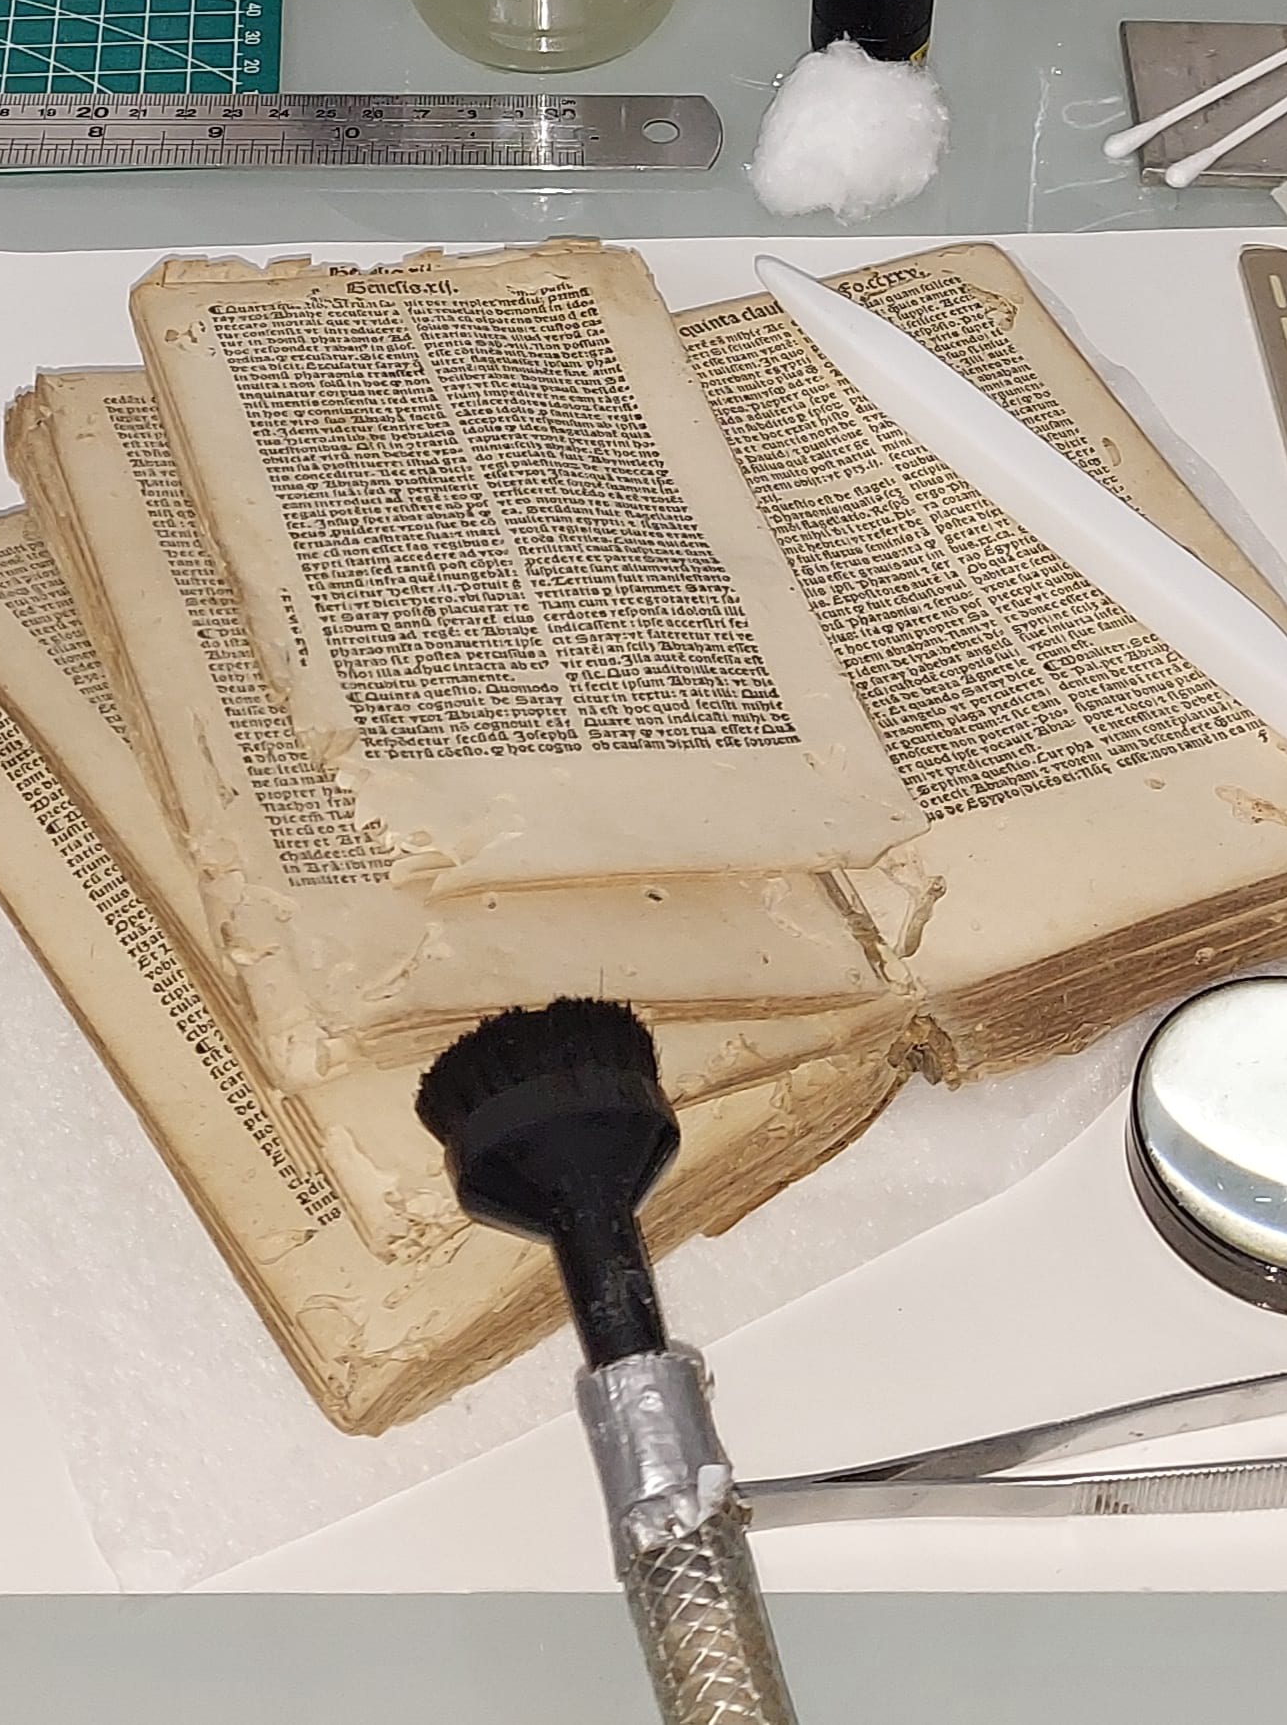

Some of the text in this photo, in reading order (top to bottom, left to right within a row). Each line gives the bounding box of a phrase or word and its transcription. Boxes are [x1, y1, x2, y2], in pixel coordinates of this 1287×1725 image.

[245, 2, 262, 17] 40
[243, 29, 262, 45] 30
[243, 59, 260, 74] 20
[37, 105, 58, 119] 19
[75, 105, 110, 120] 20
[128, 107, 149, 120] 21
[175, 107, 197, 120] 22
[221, 107, 245, 120] 23
[267, 107, 291, 119] 24
[88, 124, 105, 138] 8
[206, 124, 225, 140] 9
[332, 124, 361, 140] 10
